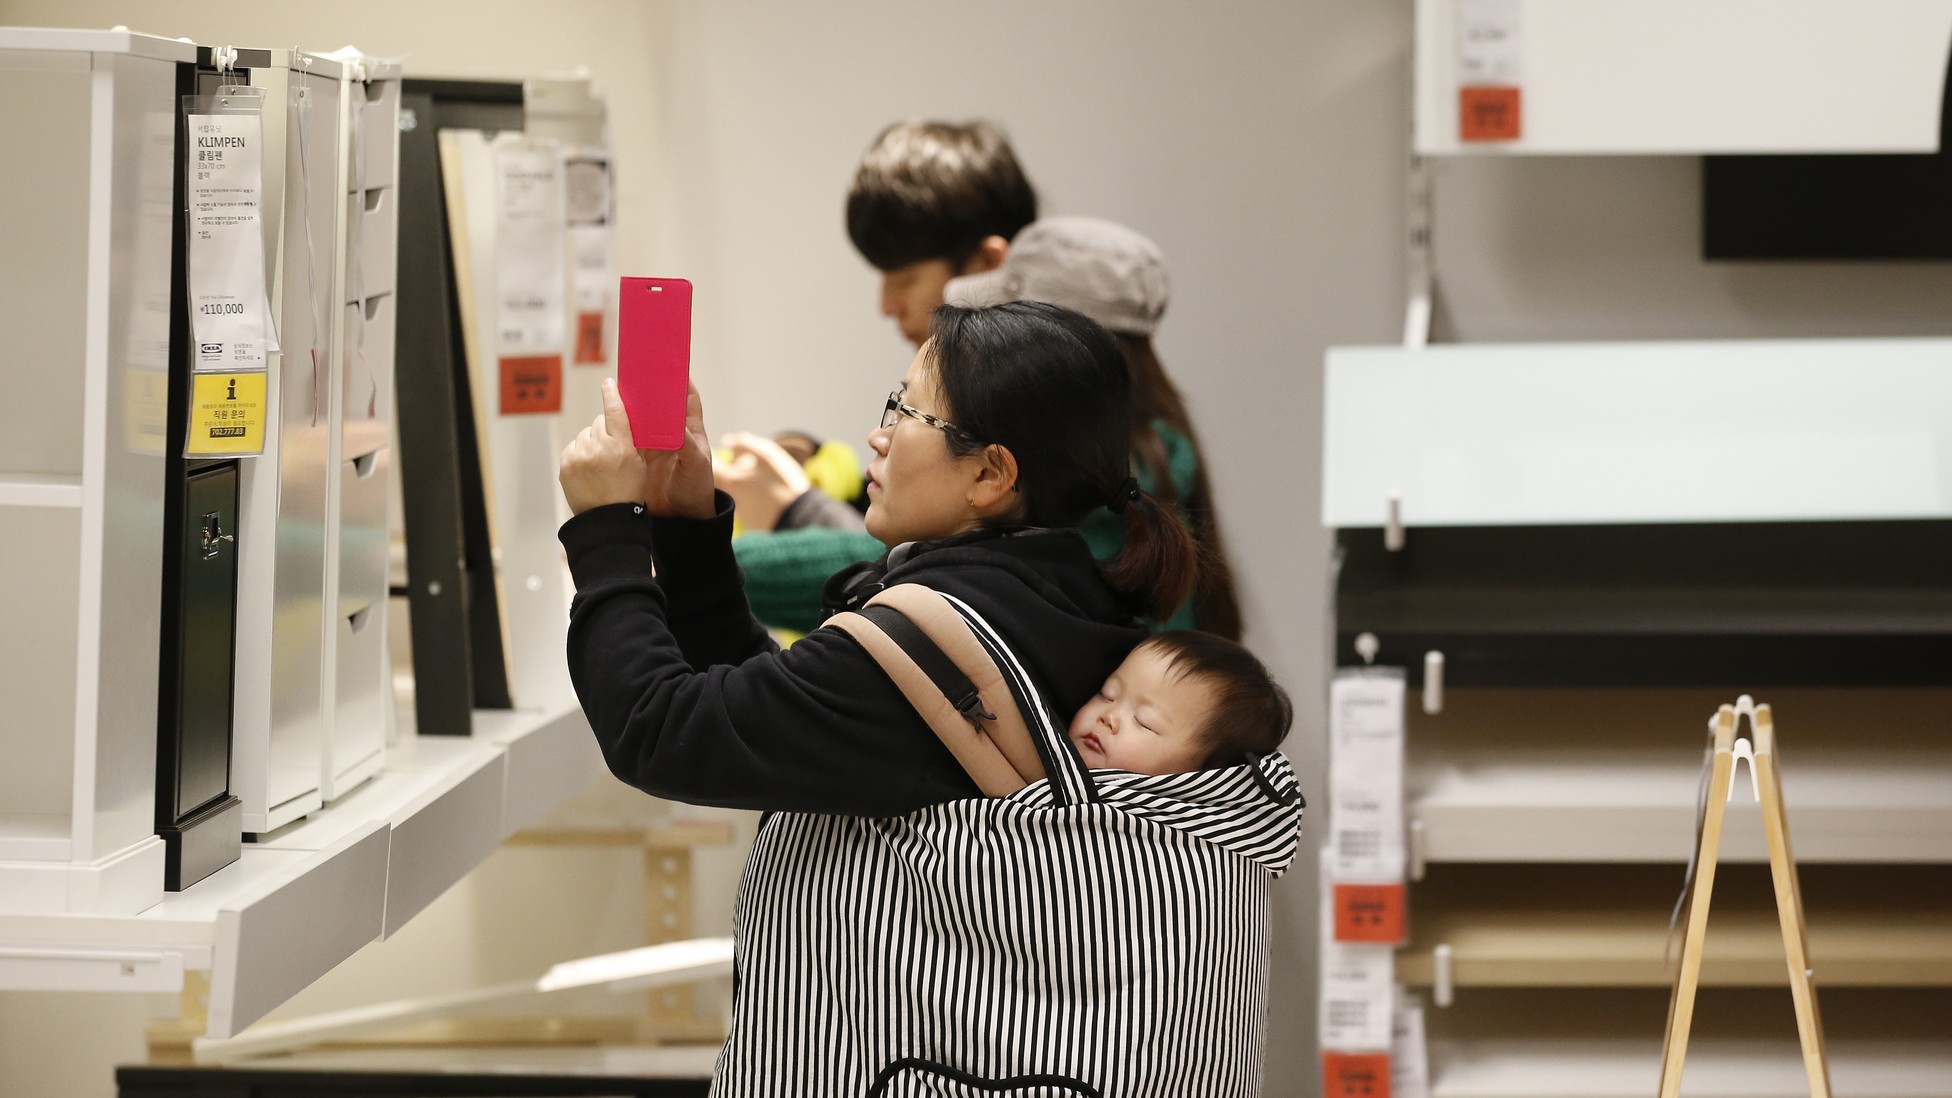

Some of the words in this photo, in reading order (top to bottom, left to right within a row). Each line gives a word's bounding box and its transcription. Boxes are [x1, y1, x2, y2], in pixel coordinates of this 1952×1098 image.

[198, 137, 245, 148] KLIMPEN
[198, 150, 223, 161] 클림펜
[214, 410, 228, 419] 직원
[231, 409, 246, 419] 문의
